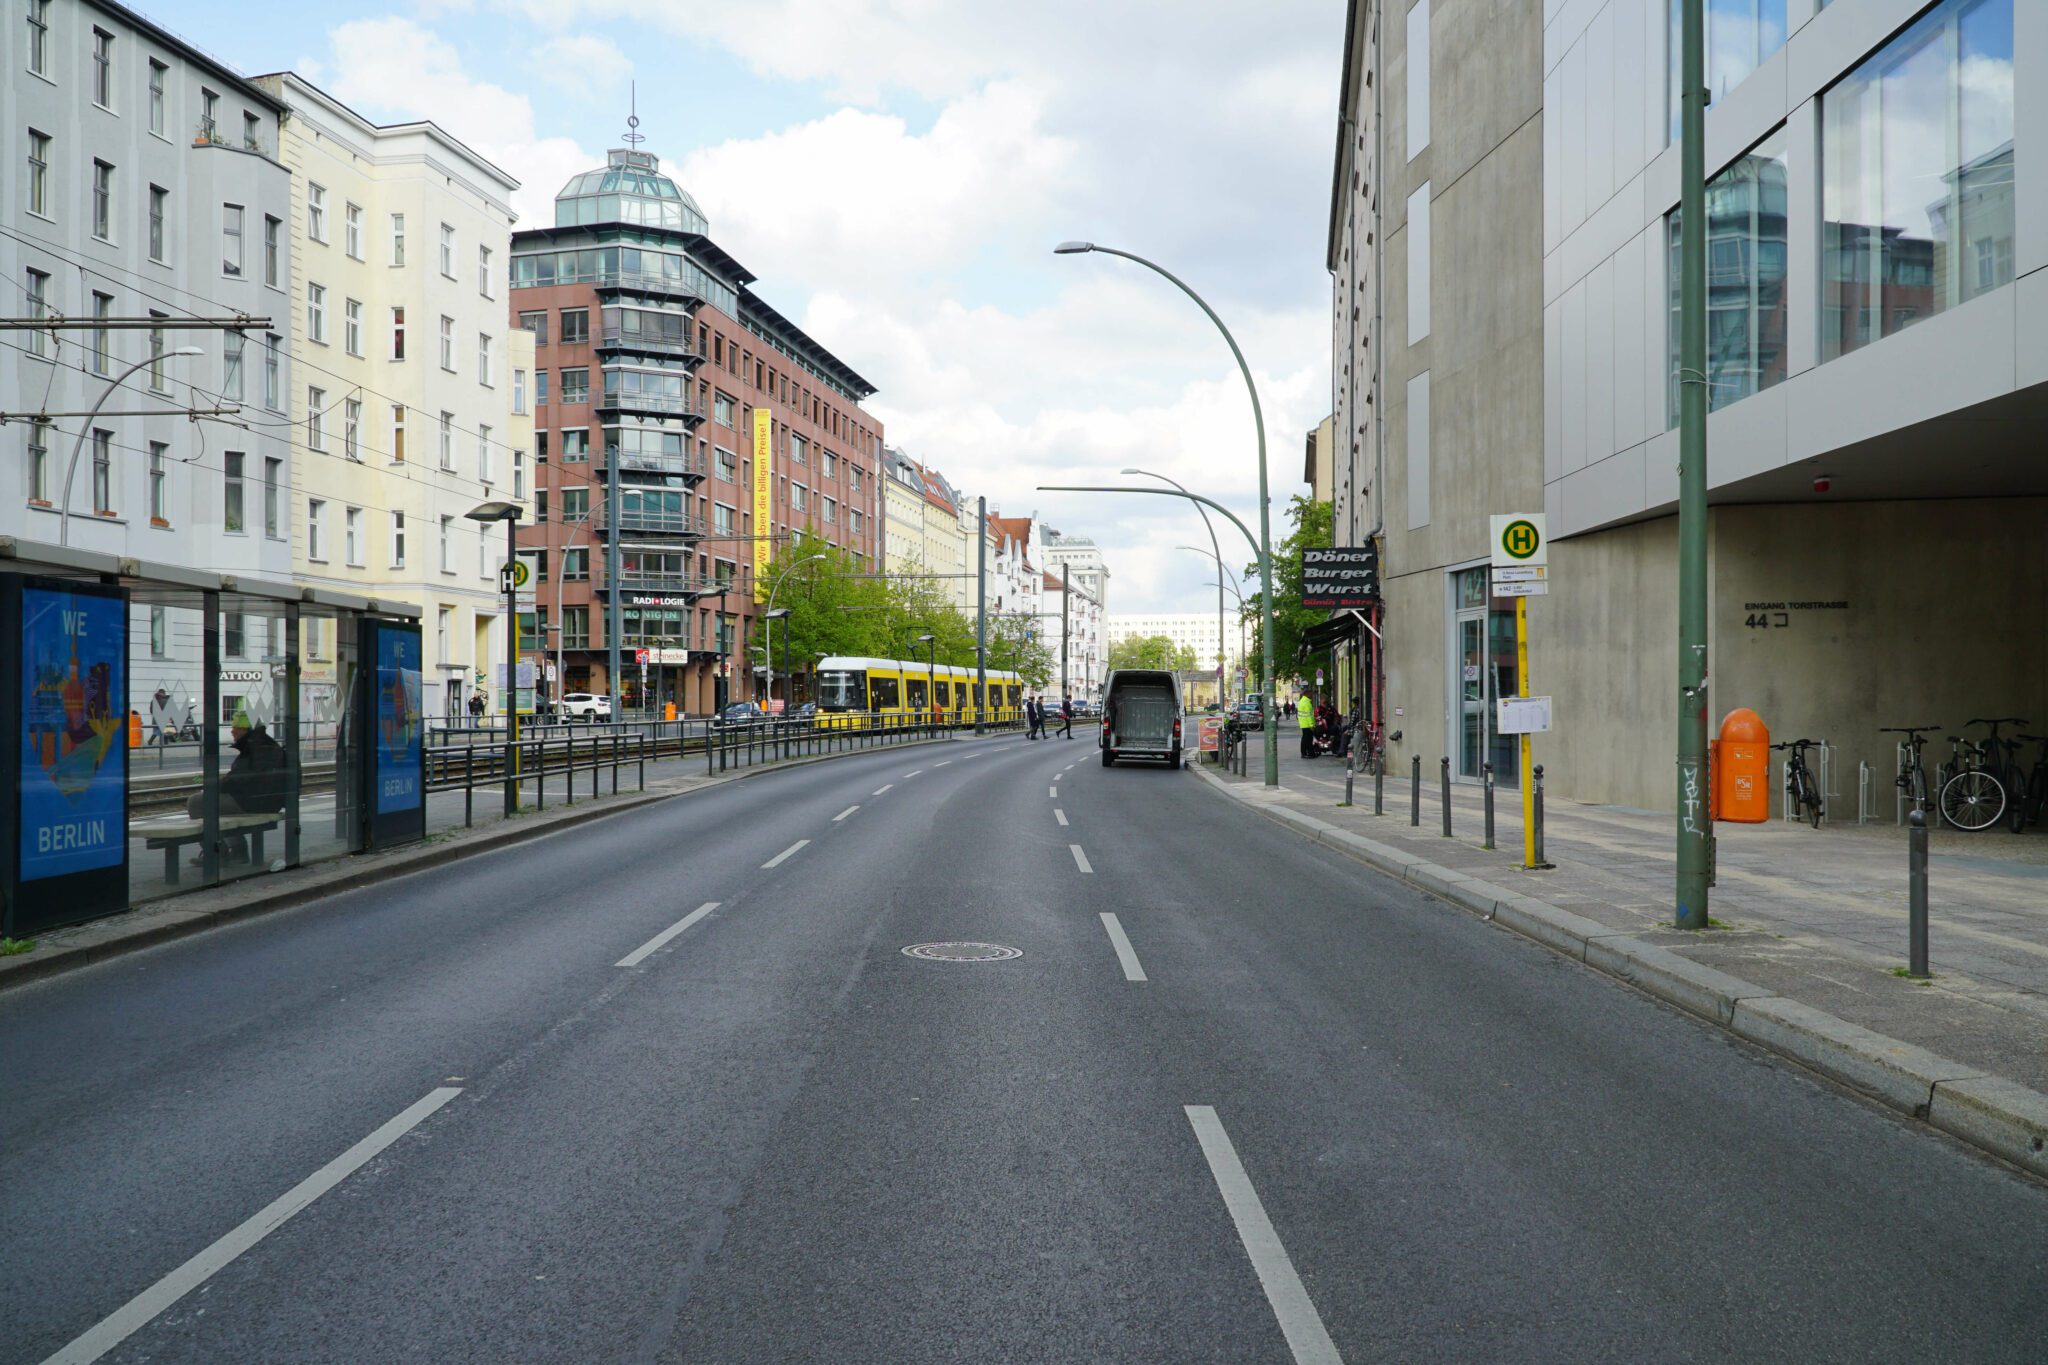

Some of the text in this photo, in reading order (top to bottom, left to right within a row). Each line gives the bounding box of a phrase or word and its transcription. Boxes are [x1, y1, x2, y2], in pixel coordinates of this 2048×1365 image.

[758, 458, 768, 492] billigen
[758, 495, 766, 509] die
[1512, 529, 1531, 550] H
[758, 545, 766, 562] Wir
[1304, 550, 1372, 562] Döner
[502, 571, 515, 592] H
[1304, 567, 1372, 580] Burger
[1304, 583, 1372, 594] Wurst
[1465, 570, 1482, 600] 42
[1745, 601, 1849, 610] EINGANG TORSTRASSE
[62, 609, 88, 637] WE
[1745, 613, 1768, 629] 44
[393, 639, 406, 658] WE
[219, 671, 262, 680] ATTOO
[384, 777, 413, 797] BERLIN
[38, 819, 105, 853] BERLIN
